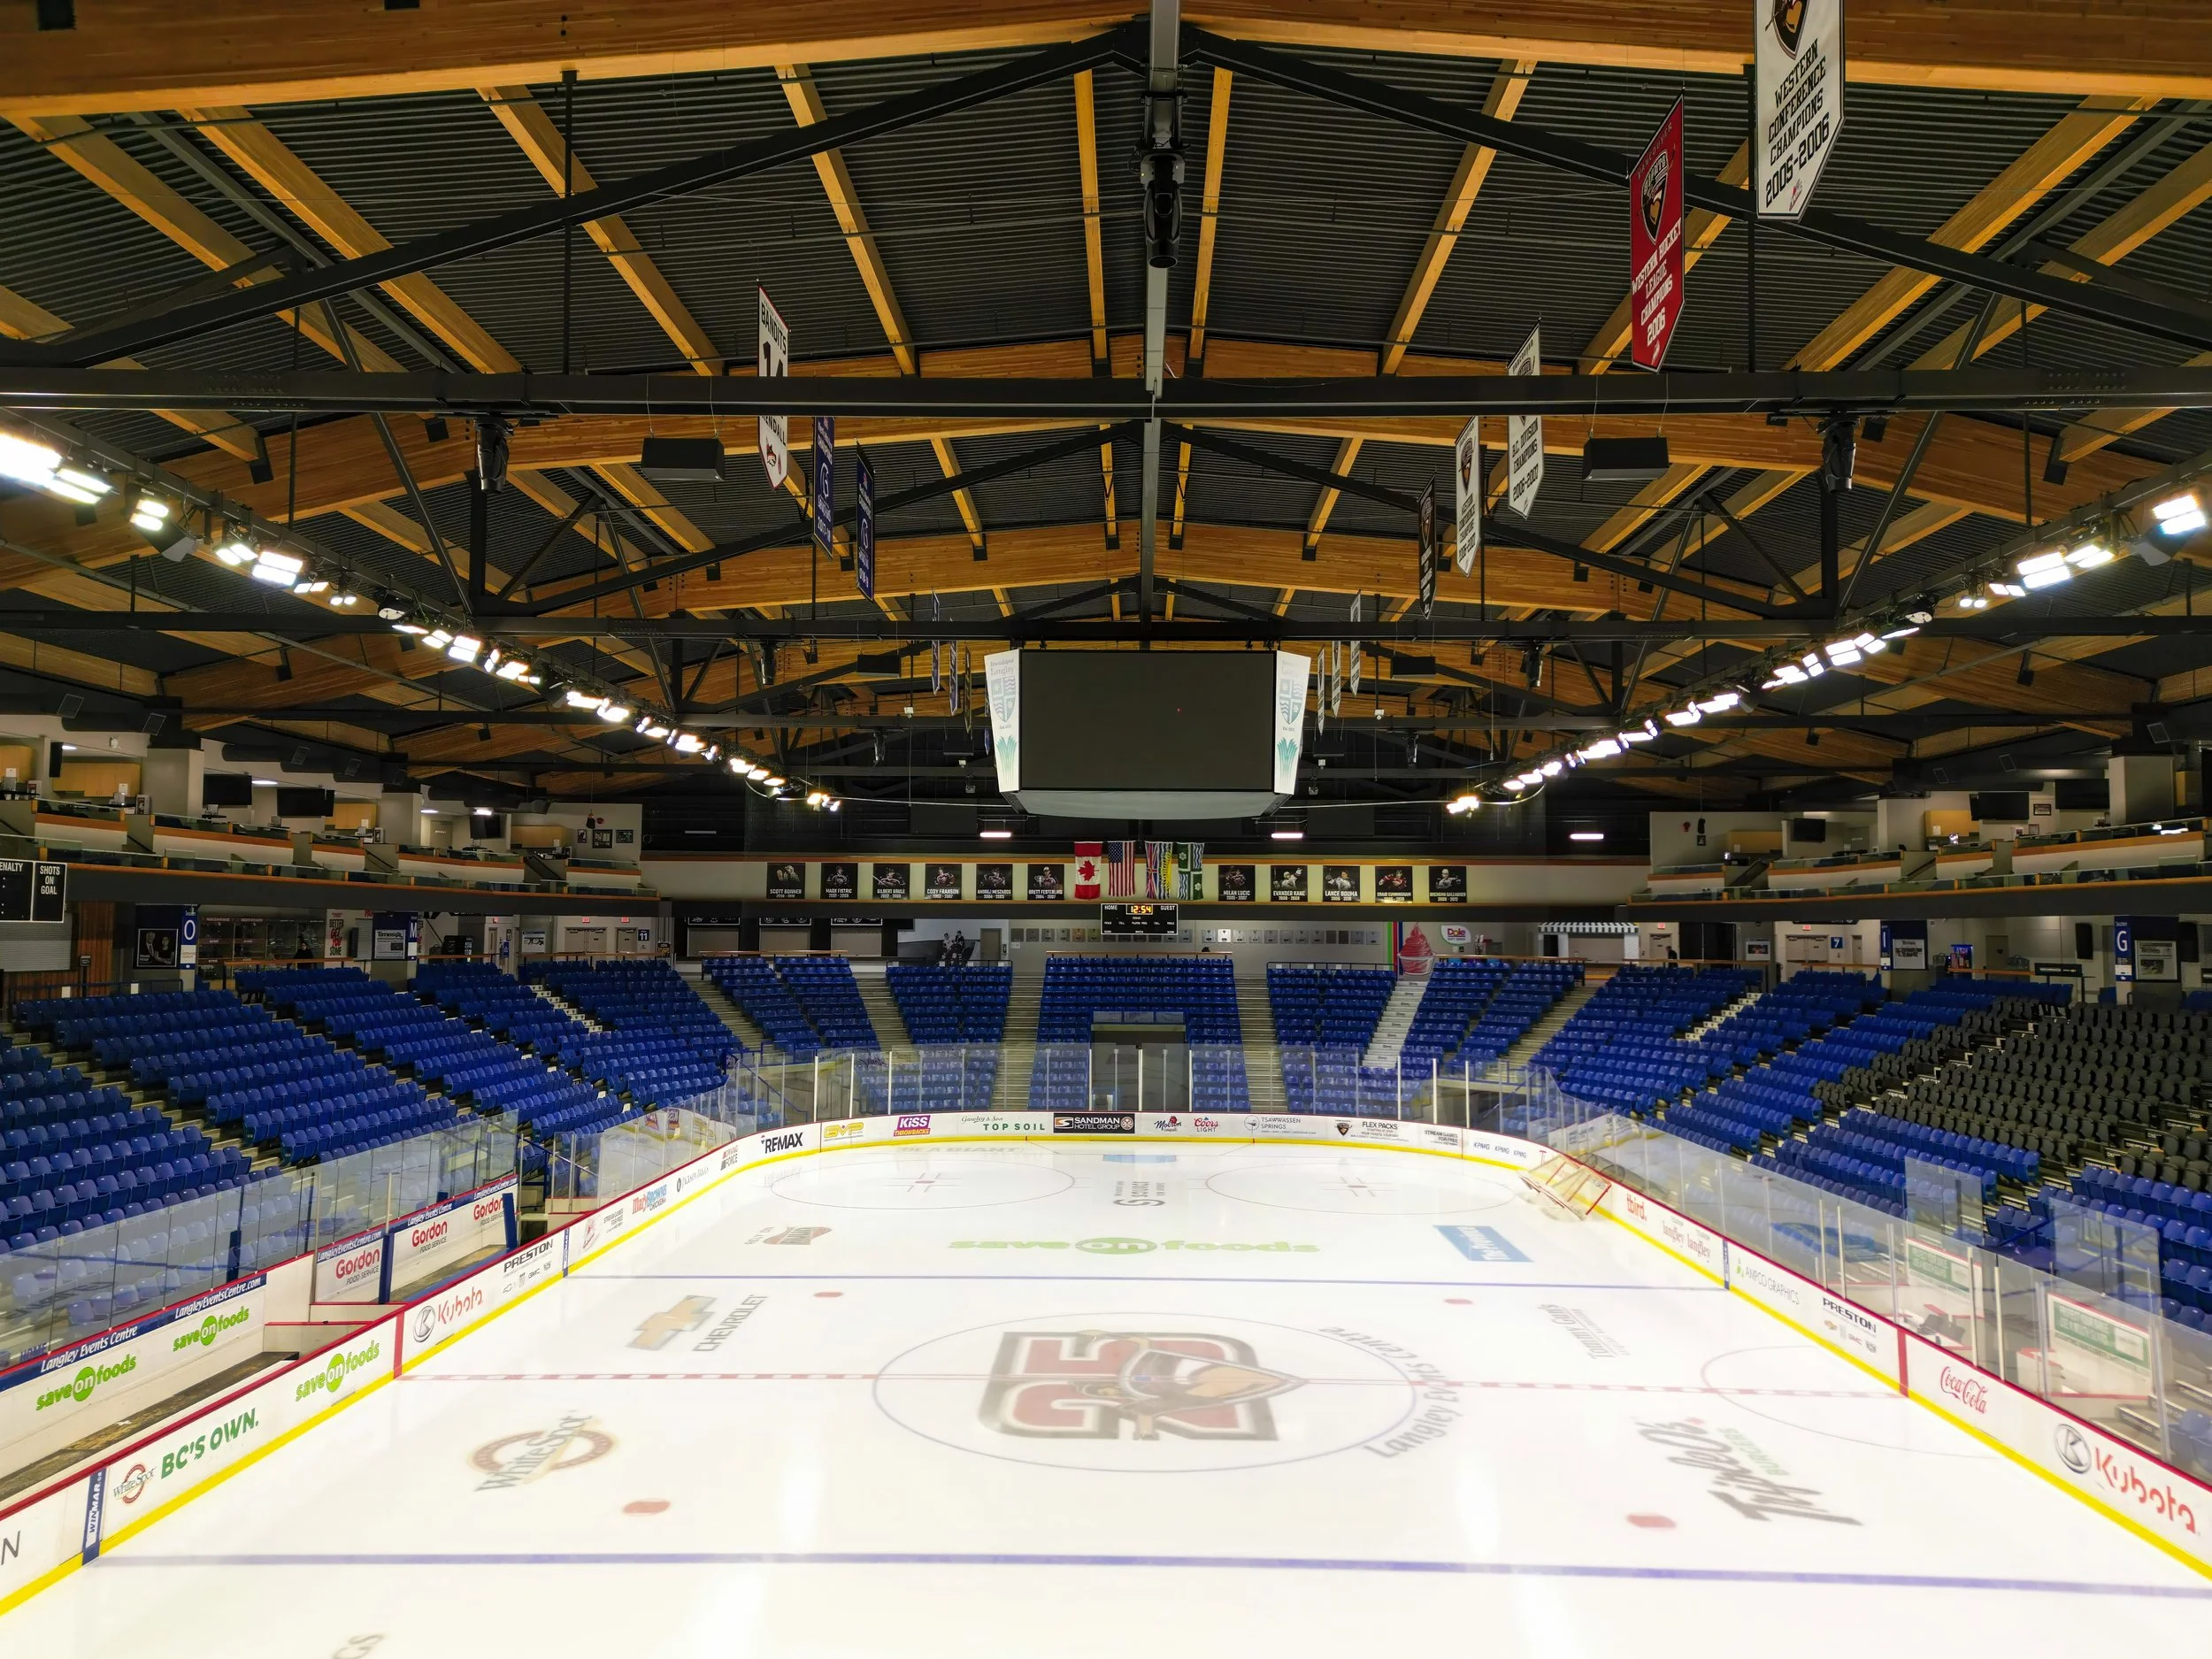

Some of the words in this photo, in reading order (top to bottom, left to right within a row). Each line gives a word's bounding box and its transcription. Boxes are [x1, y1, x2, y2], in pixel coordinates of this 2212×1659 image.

[1774, 38, 1818, 109] WESTERN
[1769, 56, 1826, 144] CONFERENCE
[1770, 88, 1824, 166] CHAMPIONS
[1637, 122, 1672, 180] VANCOUVER
[1765, 111, 1830, 209] 2005-2006
[1632, 249, 1658, 296] WESTERN
[1658, 217, 1681, 261] HOCKEY
[1646, 259, 1667, 299] LEAGUE
[1640, 273, 1672, 326] CHAMPIONS
[761, 303, 786, 355] BANDITS
[1647, 306, 1666, 347] 2006
[762, 416, 786, 445] ENDALL
[1514, 438, 1538, 474] CHAMPIONS
[40, 865, 60, 875] SHOTS
[45, 876, 54, 885] ON
[41, 886, 58, 895] GOAL
[1131, 905, 1151, 914] 12:54
[410, 922, 418, 939] M
[1448, 928, 1466, 937] Dole
[2116, 930, 2128, 952] G
[1194, 1118, 1218, 1127] Coors
[726, 1154, 738, 1168] FORCE
[1494, 1145, 1509, 1154] KPMG
[407, 1216, 425, 1226] Langley
[425, 1209, 439, 1222] Events
[439, 1202, 453, 1217] Centre
[473, 1196, 504, 1221] Gordon
[480, 1216, 489, 1226] FOOD
[317, 1231, 382, 1262] LangleyEventsCentre.com
[412, 1220, 448, 1248] Gordon
[419, 1240, 431, 1253] FOOD
[431, 1236, 447, 1248] SERVICE
[949, 1240, 1071, 1250] save
[1078, 1240, 1149, 1251] on
[1162, 1239, 1321, 1253] foods
[336, 1248, 380, 1279] Gordon
[503, 1239, 553, 1272] PRESTON
[347, 1272, 360, 1286] FOOD
[360, 1265, 379, 1281] SERVICE
[528, 1268, 540, 1279] GMC
[1746, 1266, 1768, 1287] AMPCO
[1767, 1275, 1800, 1305] GRAPHICS
[174, 1276, 261, 1320] LangleyEventsCentre.com
[437, 1286, 483, 1324] Kubota
[173, 1334, 200, 1352] save
[202, 1323, 217, 1338] on
[218, 1306, 250, 1333] foods
[692, 1294, 772, 1352] CHEVROLET
[1823, 1297, 1877, 1333] PRESTON
[41, 1348, 79, 1373] Langley
[80, 1333, 108, 1358] Events
[110, 1325, 138, 1346] Centre
[1317, 1327, 1419, 1359] Centre
[1848, 1333, 1862, 1345] GMC
[36, 1384, 73, 1410] save
[73, 1375, 94, 1394] on
[96, 1354, 137, 1386] foods
[296, 1377, 326, 1402] save
[326, 1362, 345, 1381] on
[345, 1340, 380, 1371] foods
[1939, 1366, 1988, 1414] Coca-Cola
[160, 1437, 205, 1479] BC'S
[211, 1407, 260, 1452] OWN.
[1363, 1405, 1464, 1458] Langley
[113, 1479, 135, 1498] White
[2095, 1447, 2196, 1534] Kubota
